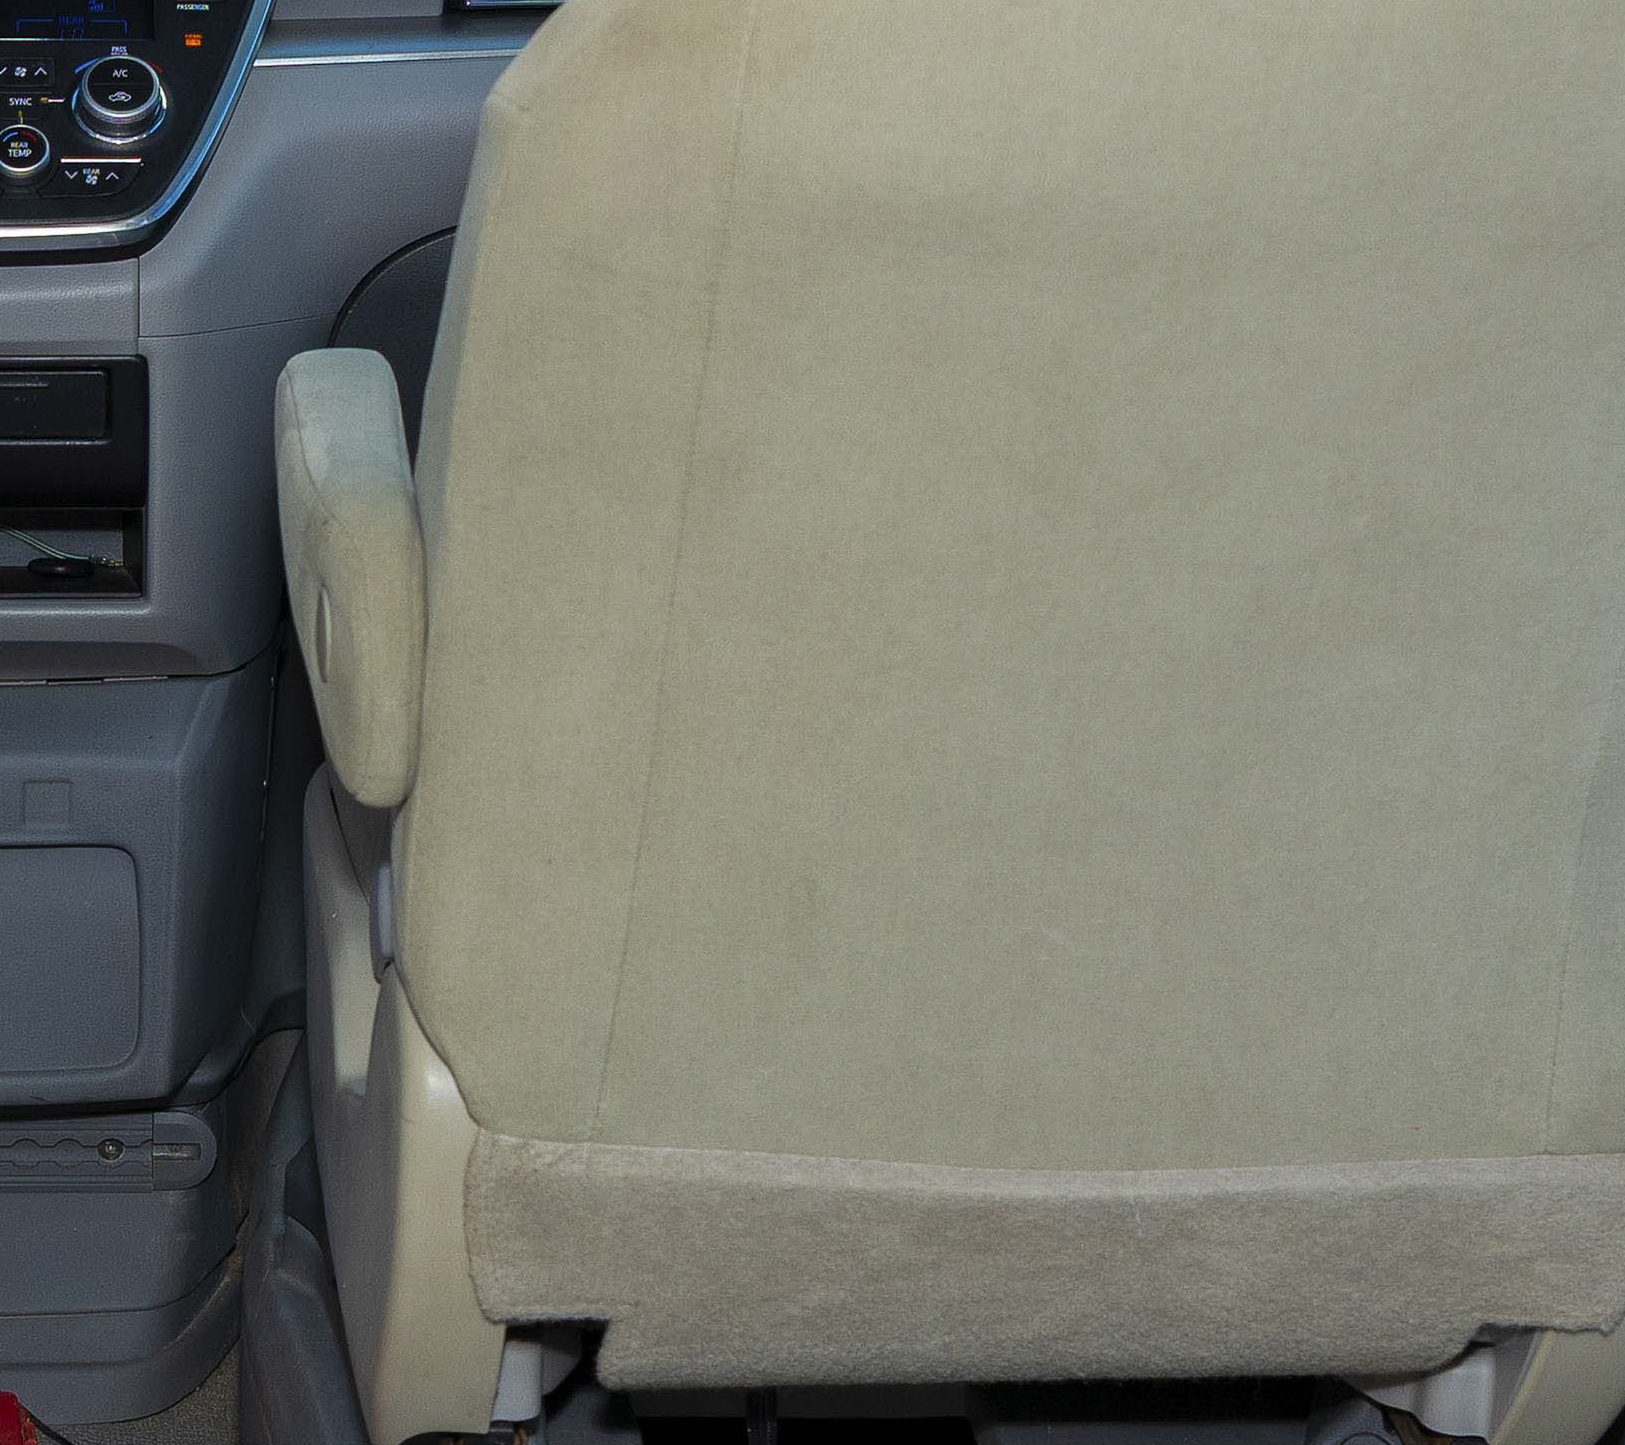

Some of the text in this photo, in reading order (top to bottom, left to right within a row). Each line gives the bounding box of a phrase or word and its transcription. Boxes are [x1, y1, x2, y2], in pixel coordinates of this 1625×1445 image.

[176, 3, 210, 12] PASSENGER
[110, 45, 128, 53] PASS
[112, 68, 128, 78] A/C
[8, 96, 33, 107] SYNC
[10, 141, 29, 149] REAR
[7, 148, 32, 158] TEMP
[82, 168, 101, 176] REAR
